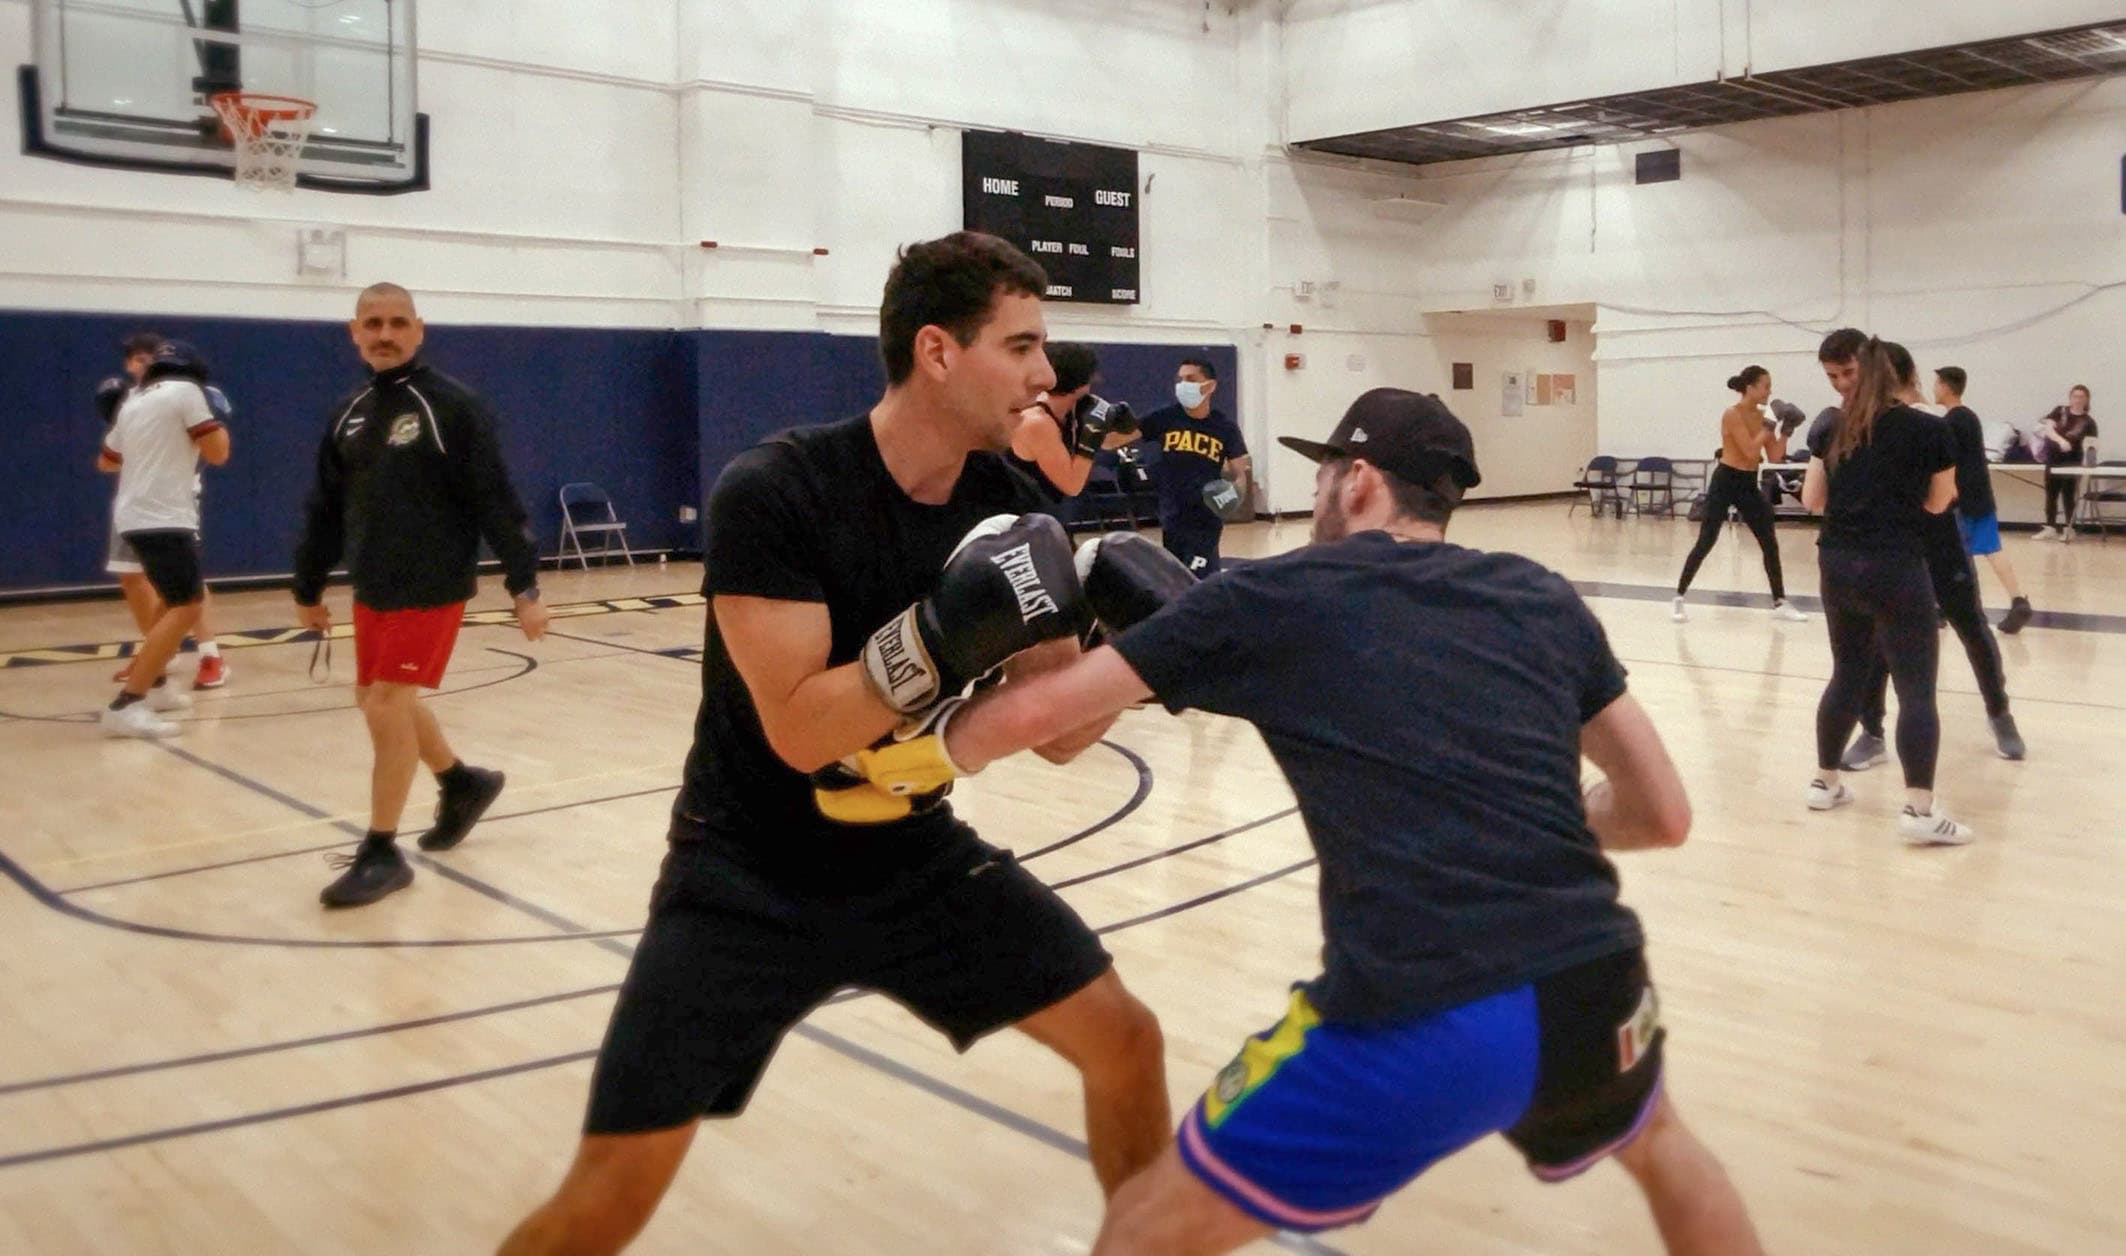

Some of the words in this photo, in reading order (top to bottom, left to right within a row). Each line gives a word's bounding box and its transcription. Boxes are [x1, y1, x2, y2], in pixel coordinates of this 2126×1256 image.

[983, 177, 1019, 196] HOME
[1045, 195, 1073, 208] PERIOD
[1095, 190, 1131, 207] GUEST
[1032, 240, 1062, 253] PLAYER
[1069, 243, 1089, 256] FOUL
[1111, 246, 1134, 258] FOULS
[1163, 430, 1223, 462] PACE
[1189, 555, 1208, 571] P
[990, 542, 1059, 625] EVERLAST
[875, 614, 927, 696] EVERLAST
